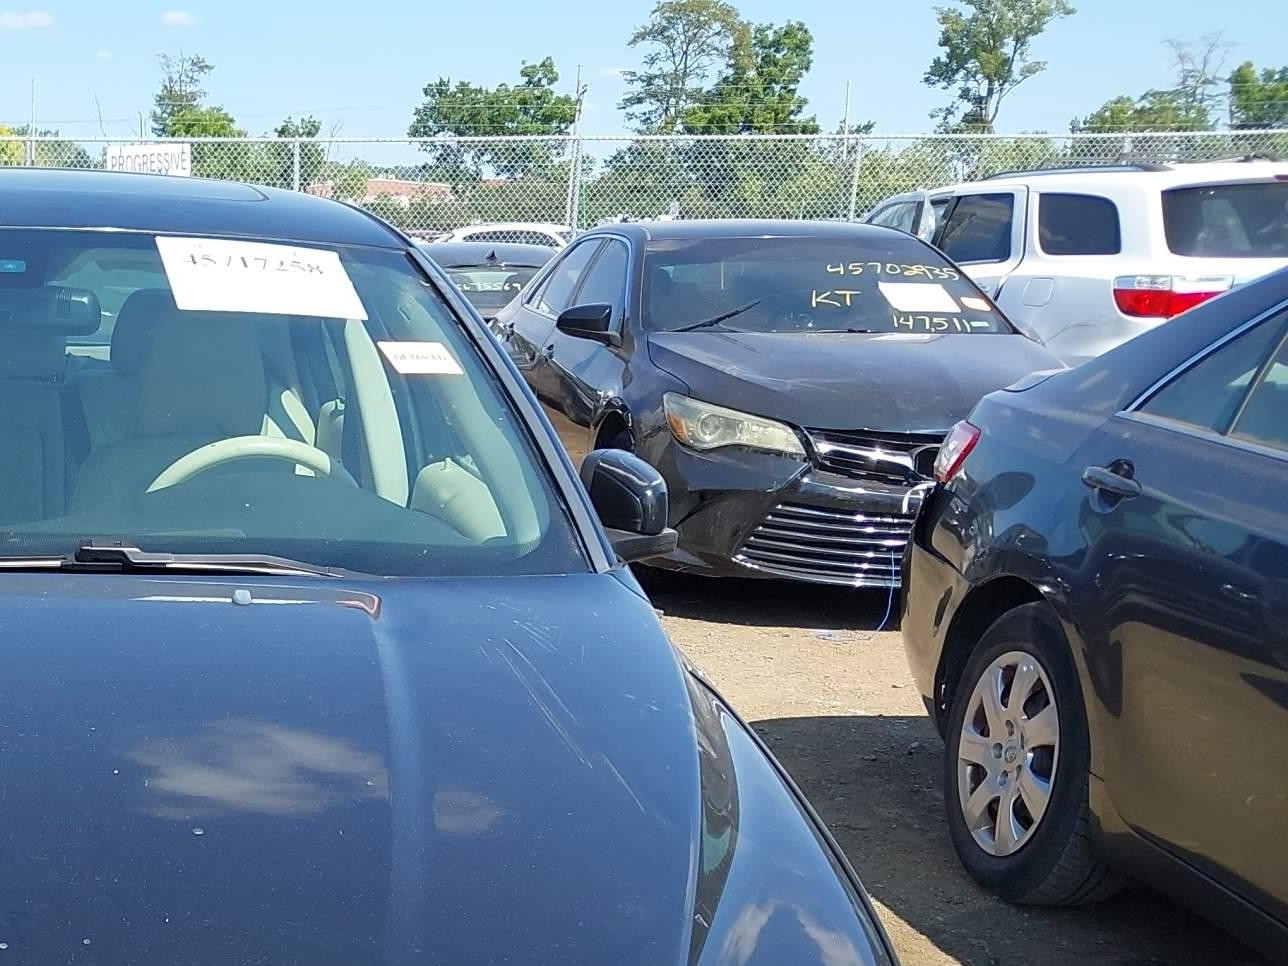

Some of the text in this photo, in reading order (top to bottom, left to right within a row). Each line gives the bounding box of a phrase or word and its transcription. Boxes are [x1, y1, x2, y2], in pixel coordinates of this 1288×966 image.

[111, 152, 187, 173] PROGRESSIVE
[826, 262, 960, 281] 45702935
[809, 289, 862, 308] KT
